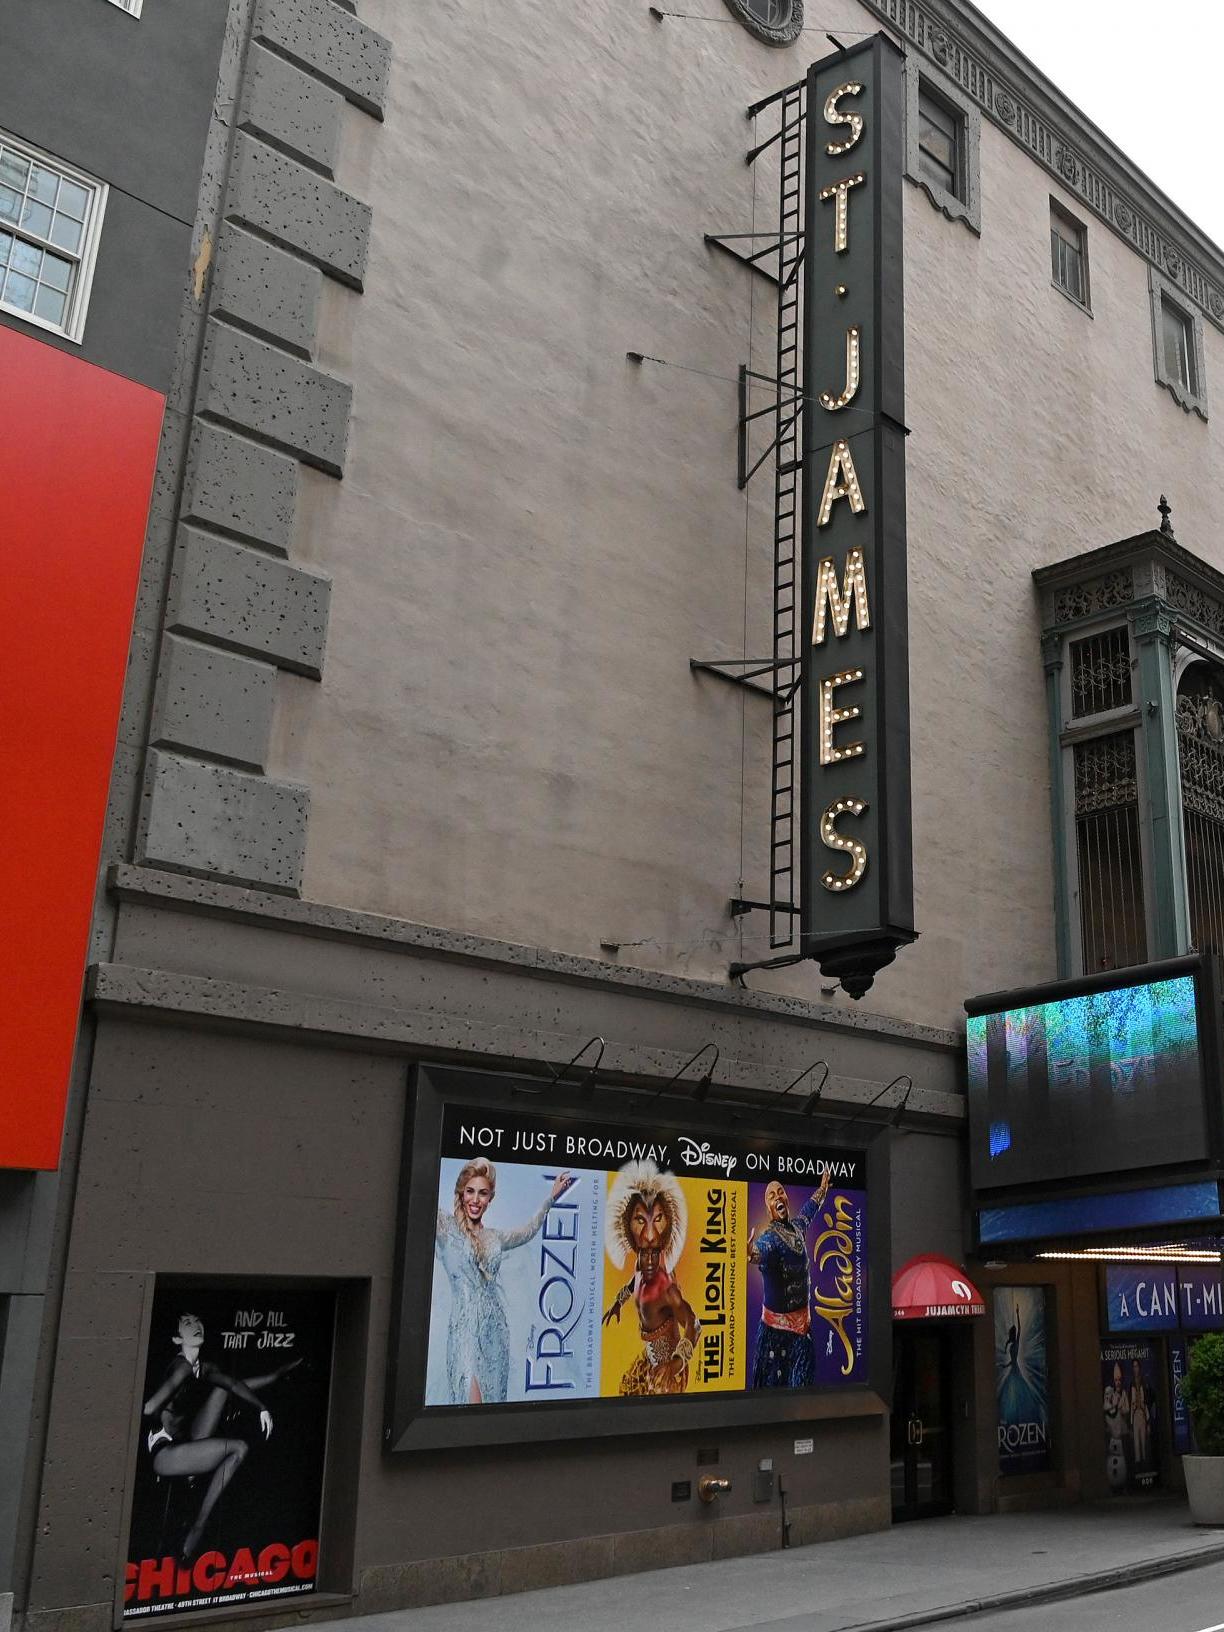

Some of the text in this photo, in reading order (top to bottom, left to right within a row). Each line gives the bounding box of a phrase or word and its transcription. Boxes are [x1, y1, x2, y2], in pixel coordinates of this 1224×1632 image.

[811, 322, 871, 892] JAMES
[460, 1126, 505, 1149] NOT
[512, 1131, 557, 1153] JUST
[566, 1136, 671, 1166] BROADWAY,
[746, 1153, 770, 1172] ON
[778, 1156, 856, 1178] BROADWAY
[729, 1236, 737, 1259] BEST
[524, 1173, 585, 1393] FROZEN
[585, 1179, 600, 1389] THE BROADWAY MUSICAL WORTH MELTING FOR
[699, 1189, 727, 1383] THE LION KING
[728, 1262, 737, 1354] AWARD-WINNING
[813, 1195, 854, 1376] Aladdin
[234, 1310, 287, 1328] AND ALL
[925, 1304, 969, 1317] JUJAMCYN
[221, 1332, 296, 1350] THAT JAZZ
[1172, 1350, 1185, 1422] FROZEN
[997, 1422, 1047, 1454] ROZEN
[150, 1601, 175, 1613] THEATRE
[192, 1597, 212, 1607] STREET
[219, 1593, 248, 1603] BROADWAY
[230, 1573, 242, 1581] THE
